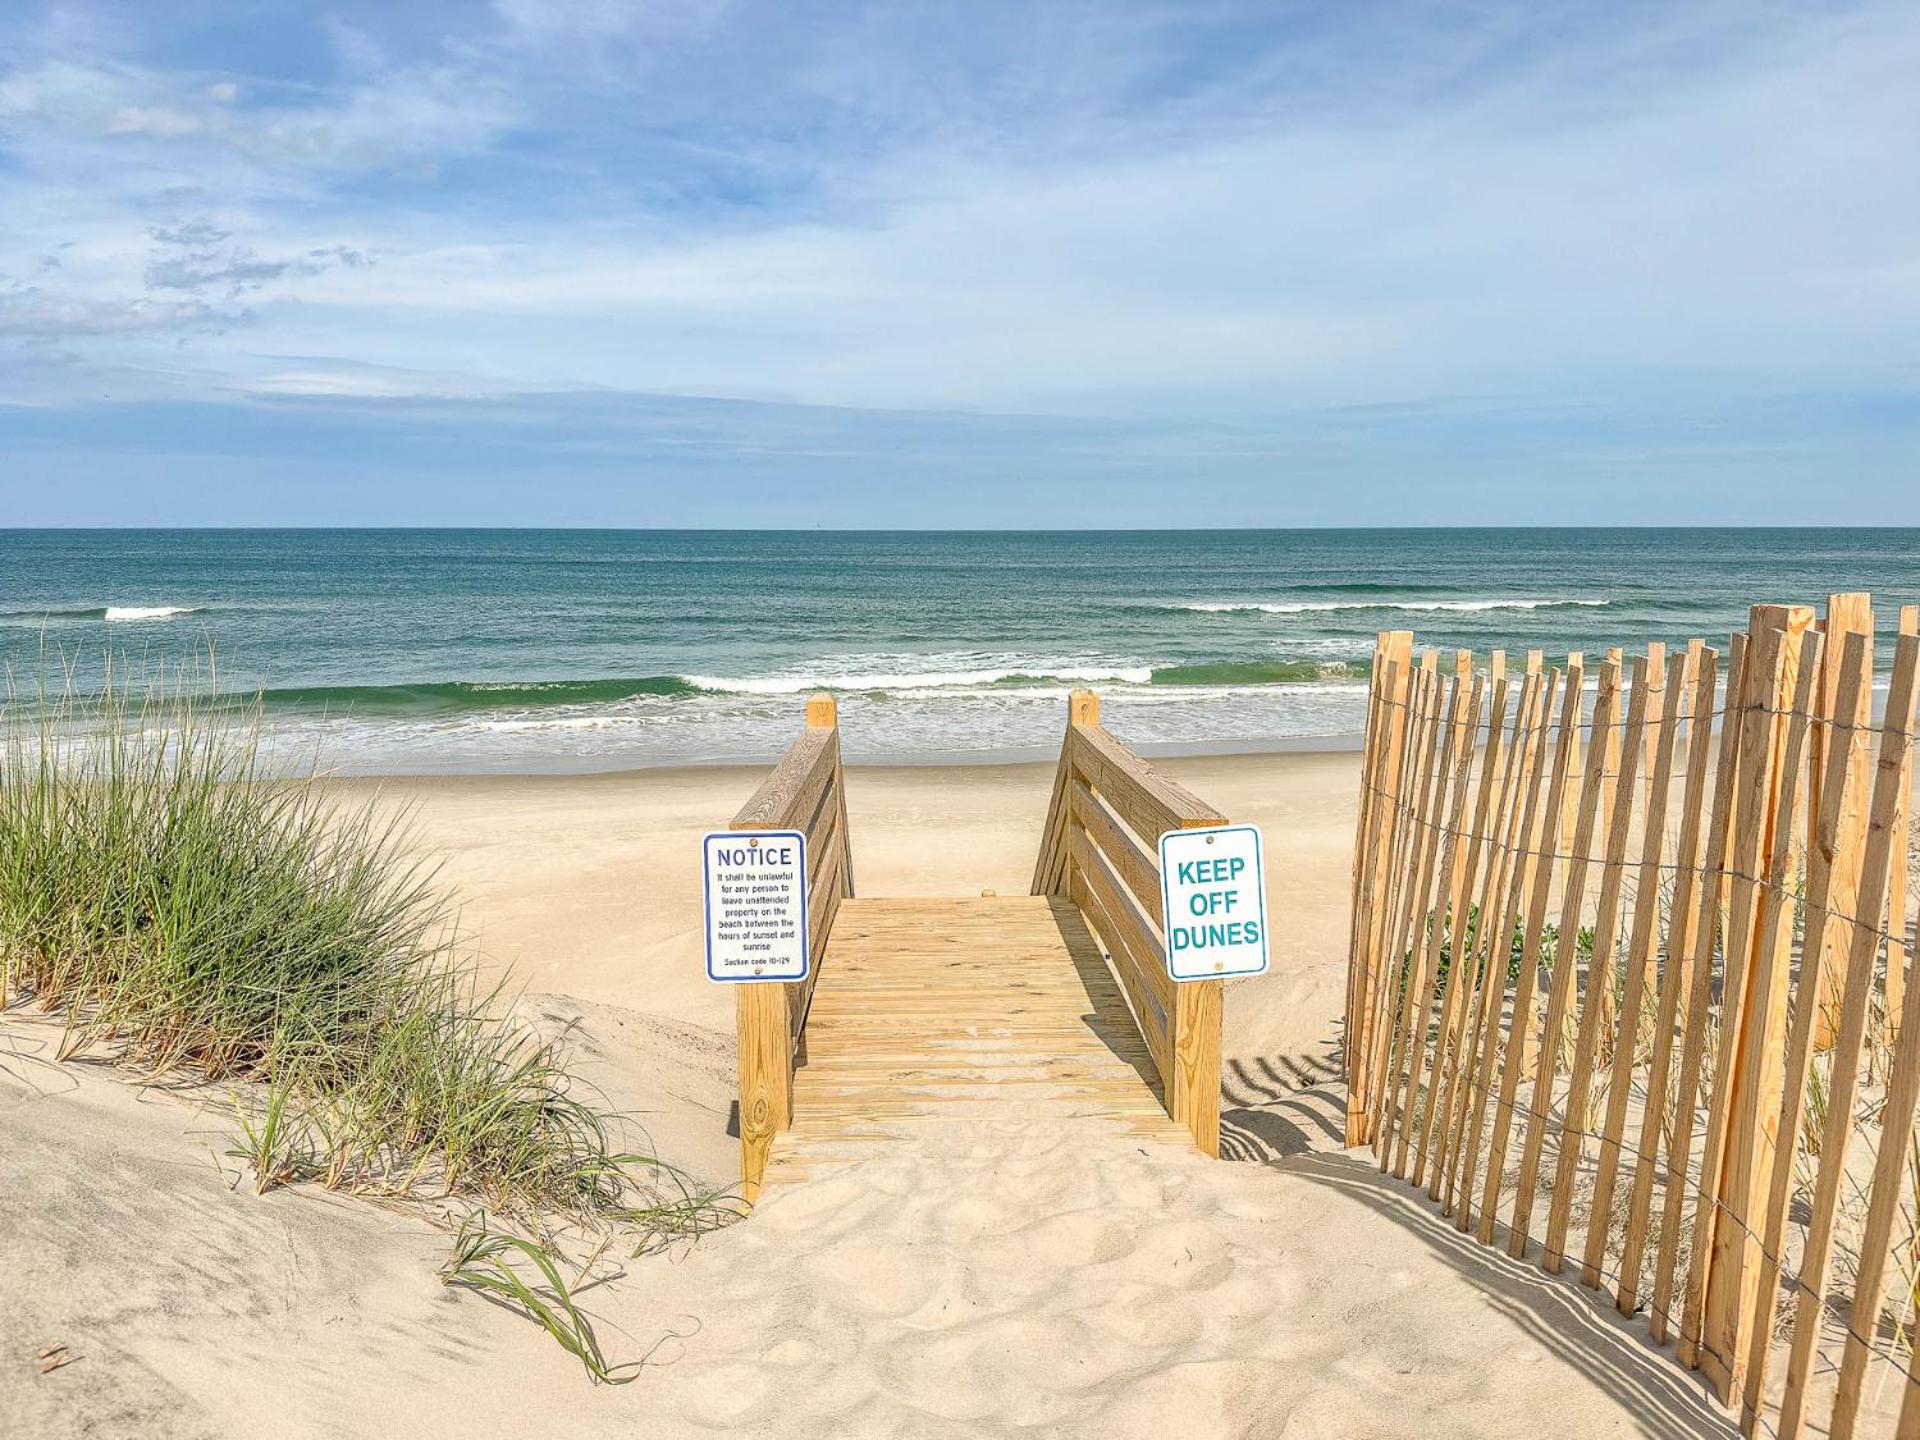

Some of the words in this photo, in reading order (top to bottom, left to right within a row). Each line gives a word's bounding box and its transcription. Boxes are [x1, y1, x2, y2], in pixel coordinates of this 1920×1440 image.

[718, 848, 792, 866] NOTICE
[1178, 858, 1245, 885] KEEP
[746, 896, 789, 904] unattended
[1190, 891, 1238, 916] OFF
[725, 909, 758, 917] property
[1174, 921, 1259, 950] DUNES
